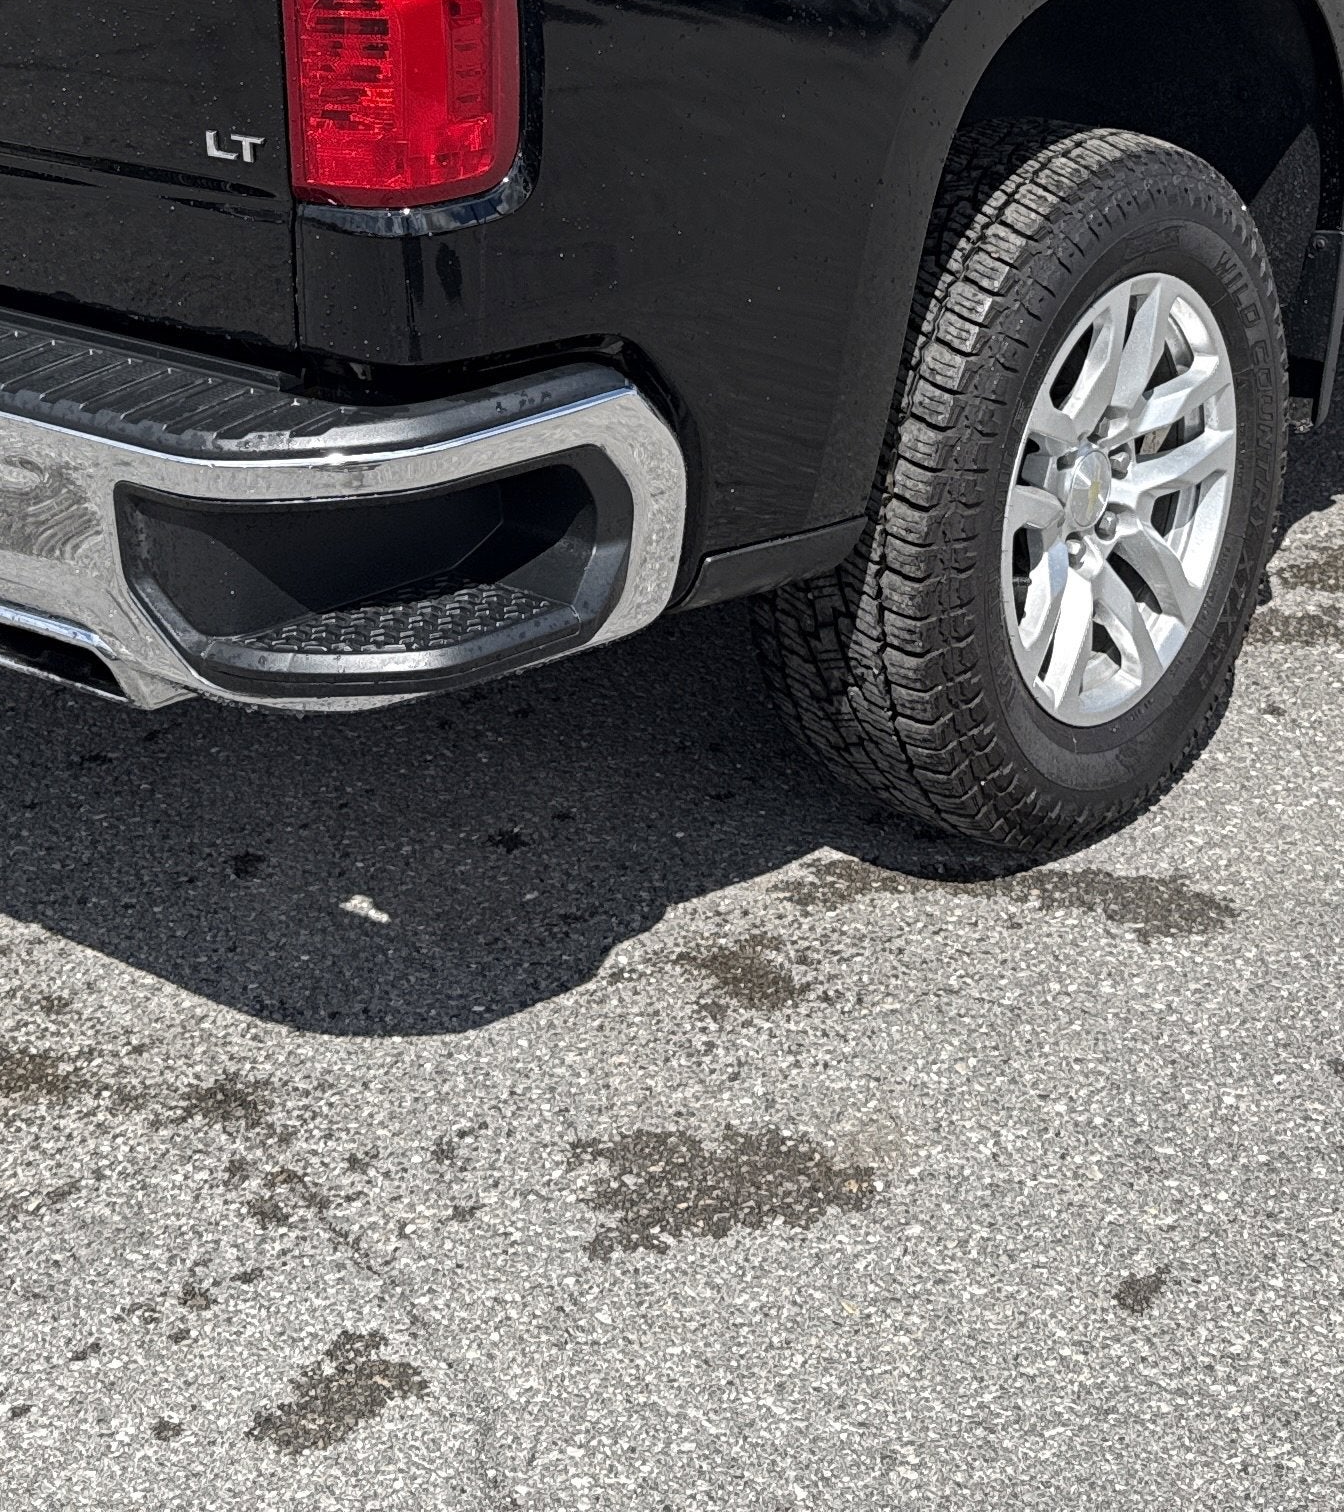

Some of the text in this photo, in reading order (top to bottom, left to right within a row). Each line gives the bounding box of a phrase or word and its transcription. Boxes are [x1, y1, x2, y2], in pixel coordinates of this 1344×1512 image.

[205, 129, 265, 163] LT
[1216, 250, 1261, 329] WILD
[1249, 339, 1274, 530] COUNTRY
